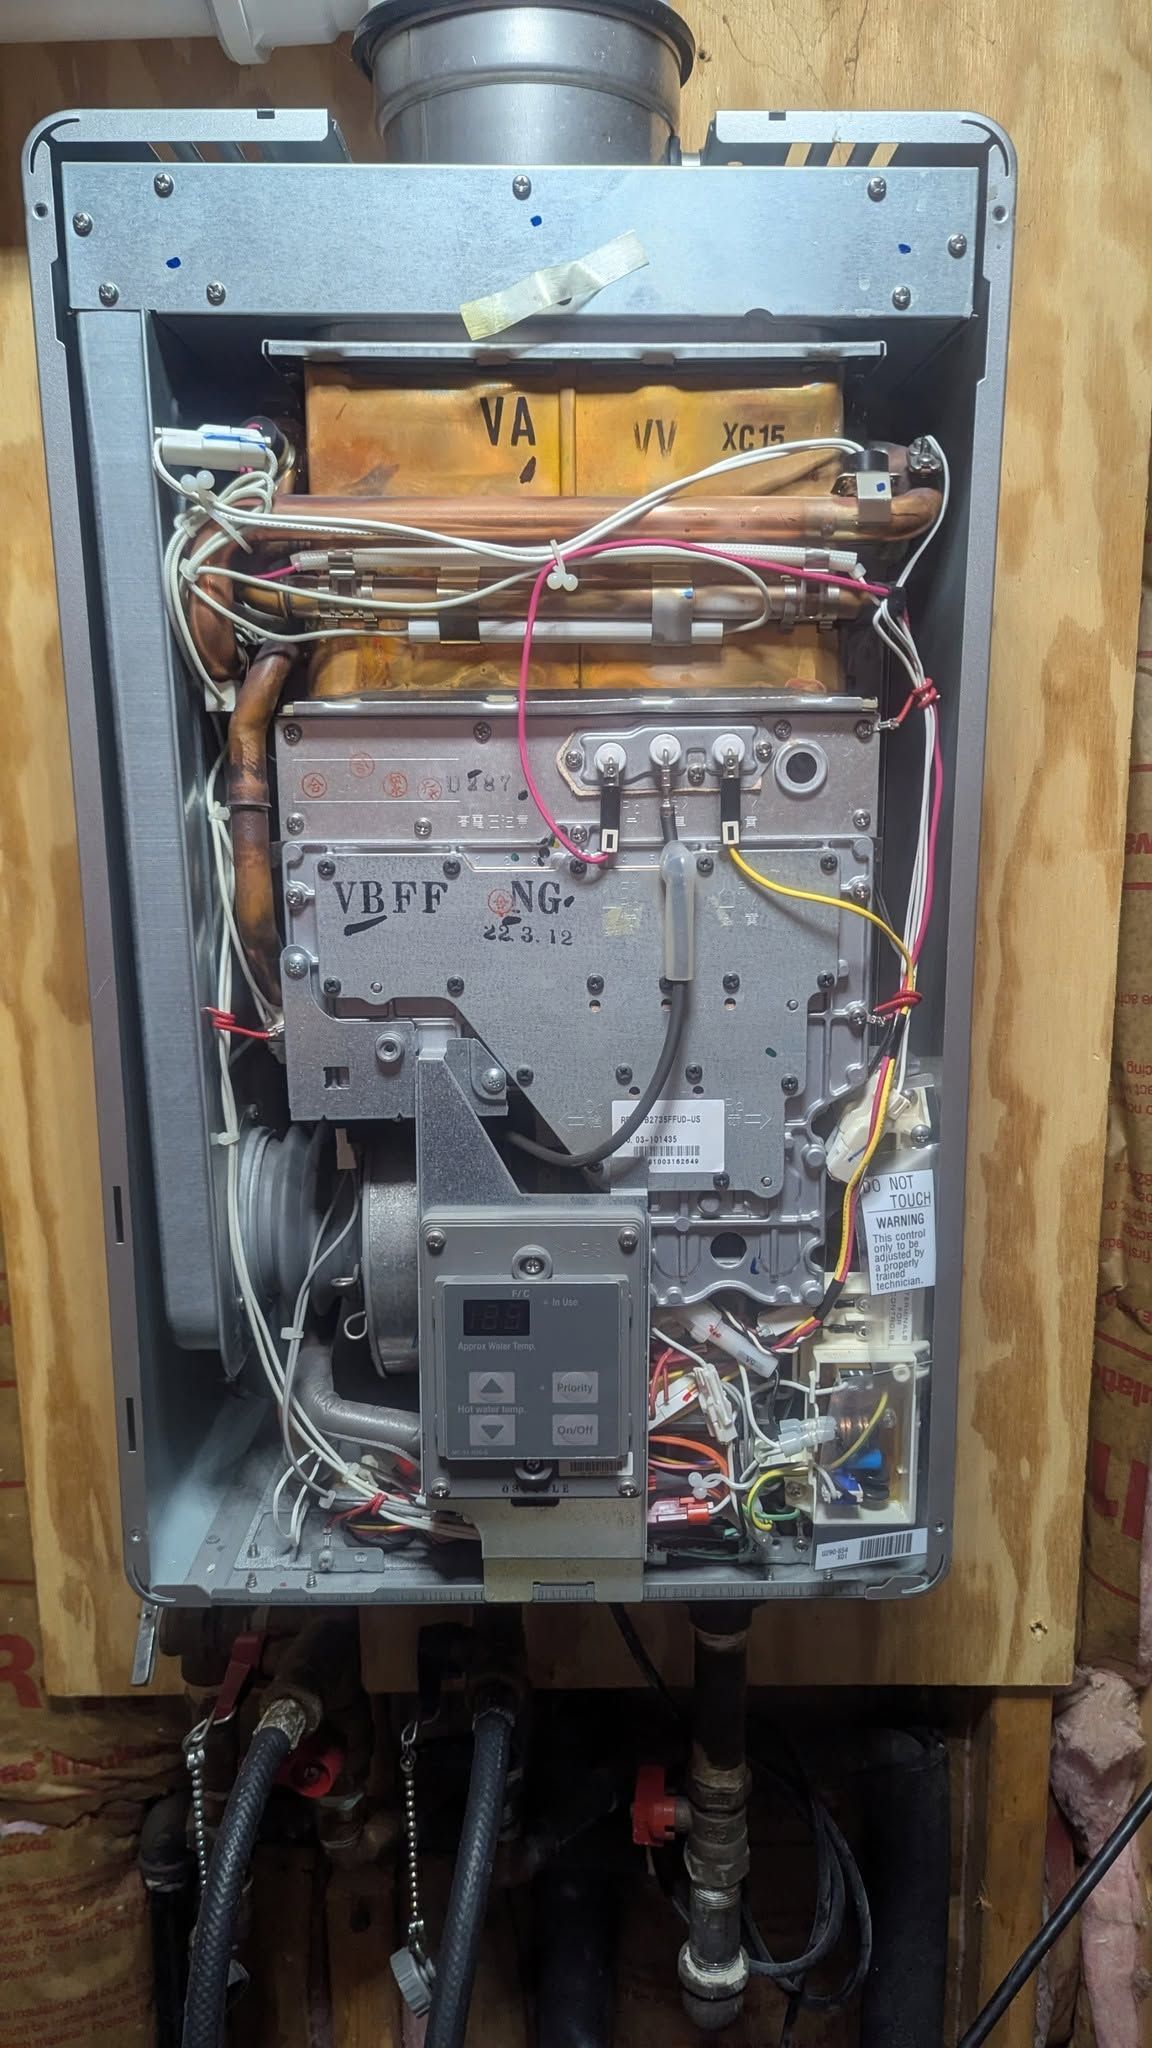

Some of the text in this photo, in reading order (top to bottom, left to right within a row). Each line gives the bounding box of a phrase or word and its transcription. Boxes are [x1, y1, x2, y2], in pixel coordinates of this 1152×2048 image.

[480, 396, 537, 448] VA
[721, 421, 786, 453] XC15
[332, 880, 449, 915] VBFF
[511, 880, 572, 915] NG
[621, 1115, 701, 1125] REB2735FFUD-US
[635, 1135, 678, 1144] 03-101435
[863, 1175, 913, 1194] DO NOT
[889, 1191, 931, 1208] TOUCH
[876, 1213, 925, 1229] WARNING
[873, 1228, 926, 1243] This control
[874, 1240, 919, 1254] only to be
[874, 1248, 924, 1263] adjusted by
[884, 1258, 919, 1271] properly
[876, 1268, 906, 1281] trained
[876, 1277, 924, 1291] technician.
[552, 1298, 578, 1306] In Use
[458, 1342, 487, 1352] Approx
[557, 1383, 593, 1395] Priority
[458, 1405, 474, 1414] Hot
[476, 1406, 500, 1414] water
[557, 1425, 594, 1436] On/Off
